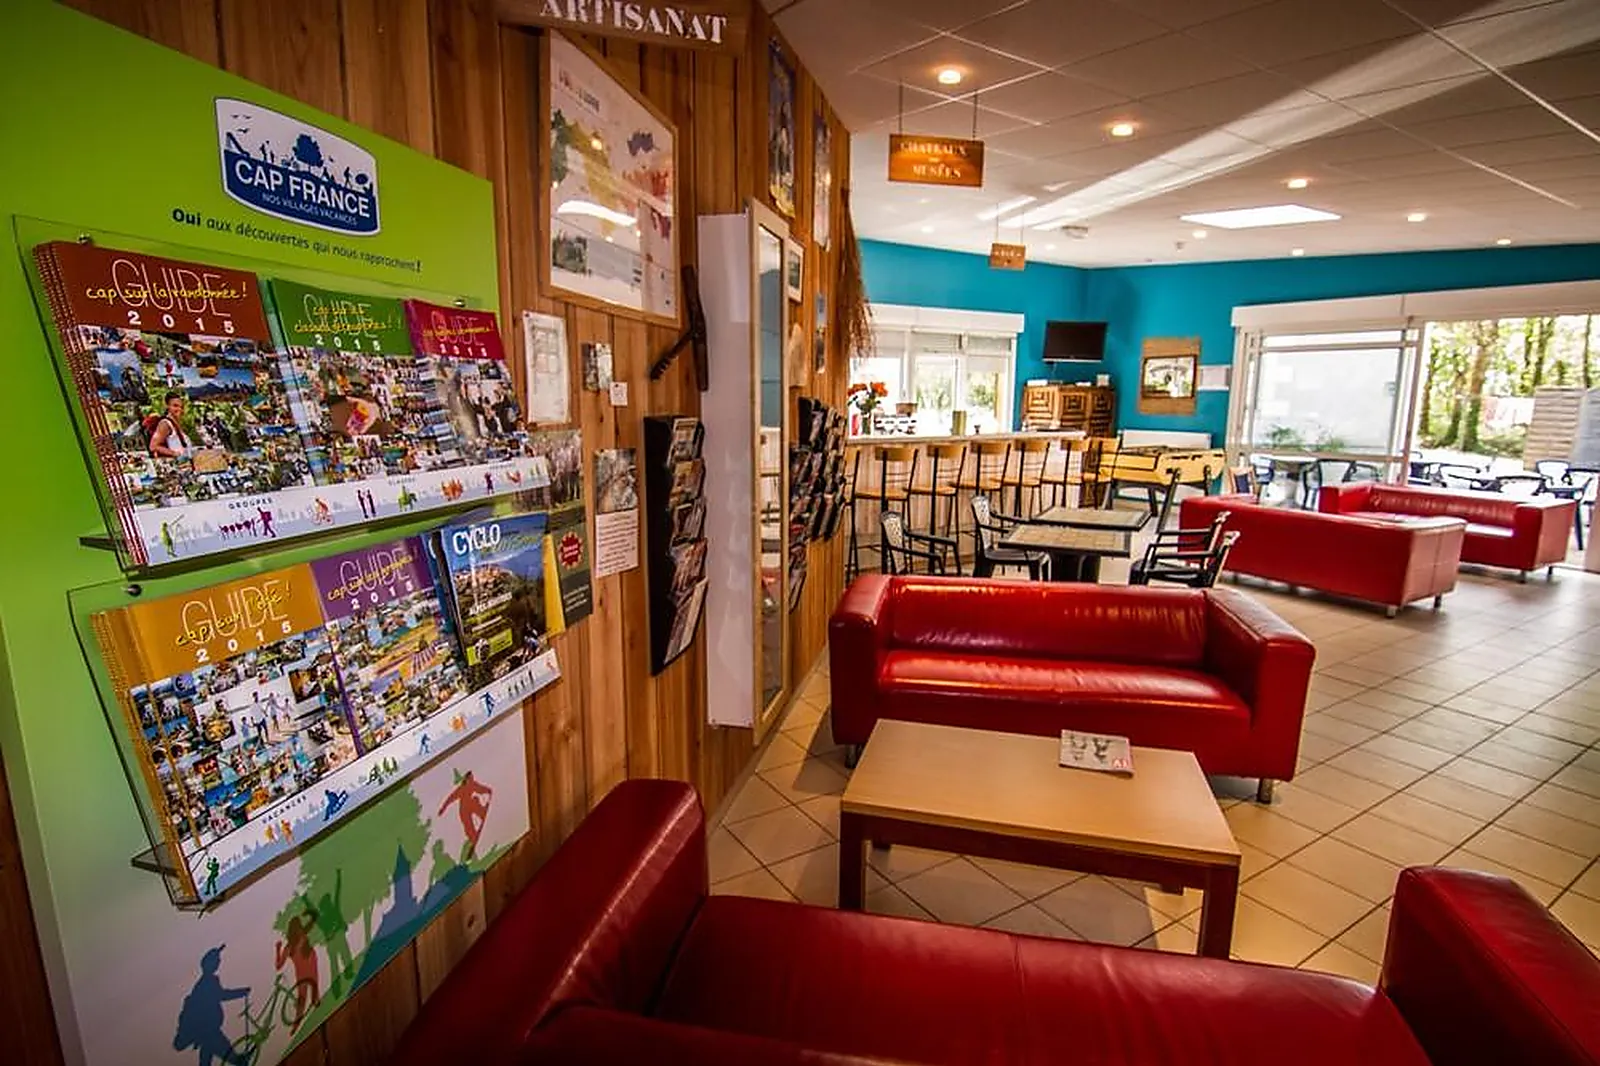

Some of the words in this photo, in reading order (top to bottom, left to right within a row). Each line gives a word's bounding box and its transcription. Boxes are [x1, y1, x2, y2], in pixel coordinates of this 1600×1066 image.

[540, 0, 727, 44] ARTISANAT
[235, 158, 283, 191] CAP
[289, 176, 371, 218] FRANCE
[262, 193, 281, 206] NOS
[282, 198, 319, 217] VILLAGES
[320, 208, 358, 226] VACANCES
[172, 207, 201, 226] Oui
[207, 216, 232, 232] aux
[236, 222, 310, 249] découvertes
[312, 240, 331, 258] qui
[332, 245, 358, 261] nous
[85, 286, 118, 305] cap
[124, 288, 151, 300] sur
[152, 282, 167, 299] la
[112, 258, 231, 317] GUIDE
[304, 294, 378, 338] GUIDE
[431, 310, 486, 346] GUIDE
[228, 497, 272, 509] GROUPES
[452, 524, 500, 556] CYCLO
[340, 548, 410, 597] GUIDE
[182, 579, 288, 644] GUIDE
[327, 586, 347, 602] cap
[176, 625, 209, 646] cap
[216, 611, 242, 628] sur
[262, 794, 306, 824] VACANCES
